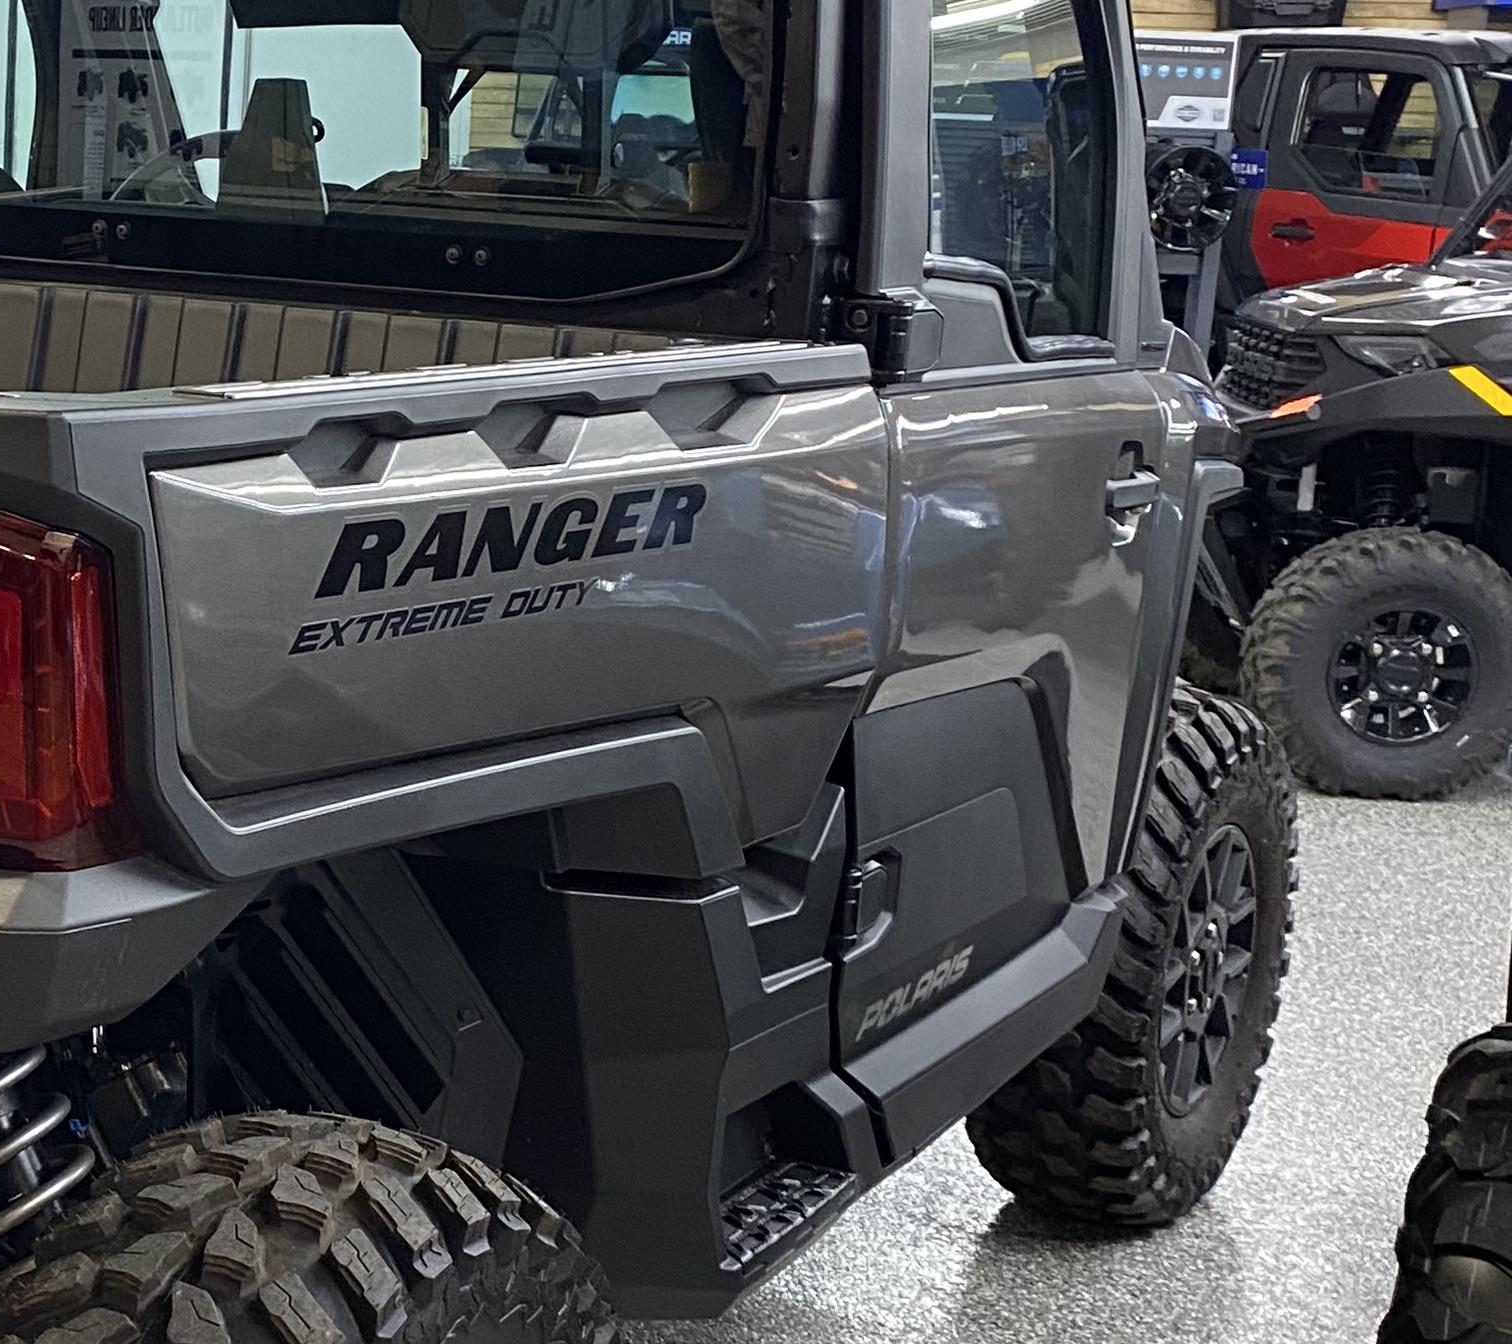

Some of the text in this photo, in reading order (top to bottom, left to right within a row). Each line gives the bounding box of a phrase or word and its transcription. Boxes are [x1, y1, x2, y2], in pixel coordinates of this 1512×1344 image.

[314, 483, 708, 600] RANGER
[288, 578, 599, 656] EXTREME DUTY
[855, 944, 975, 1042] POLARIS
